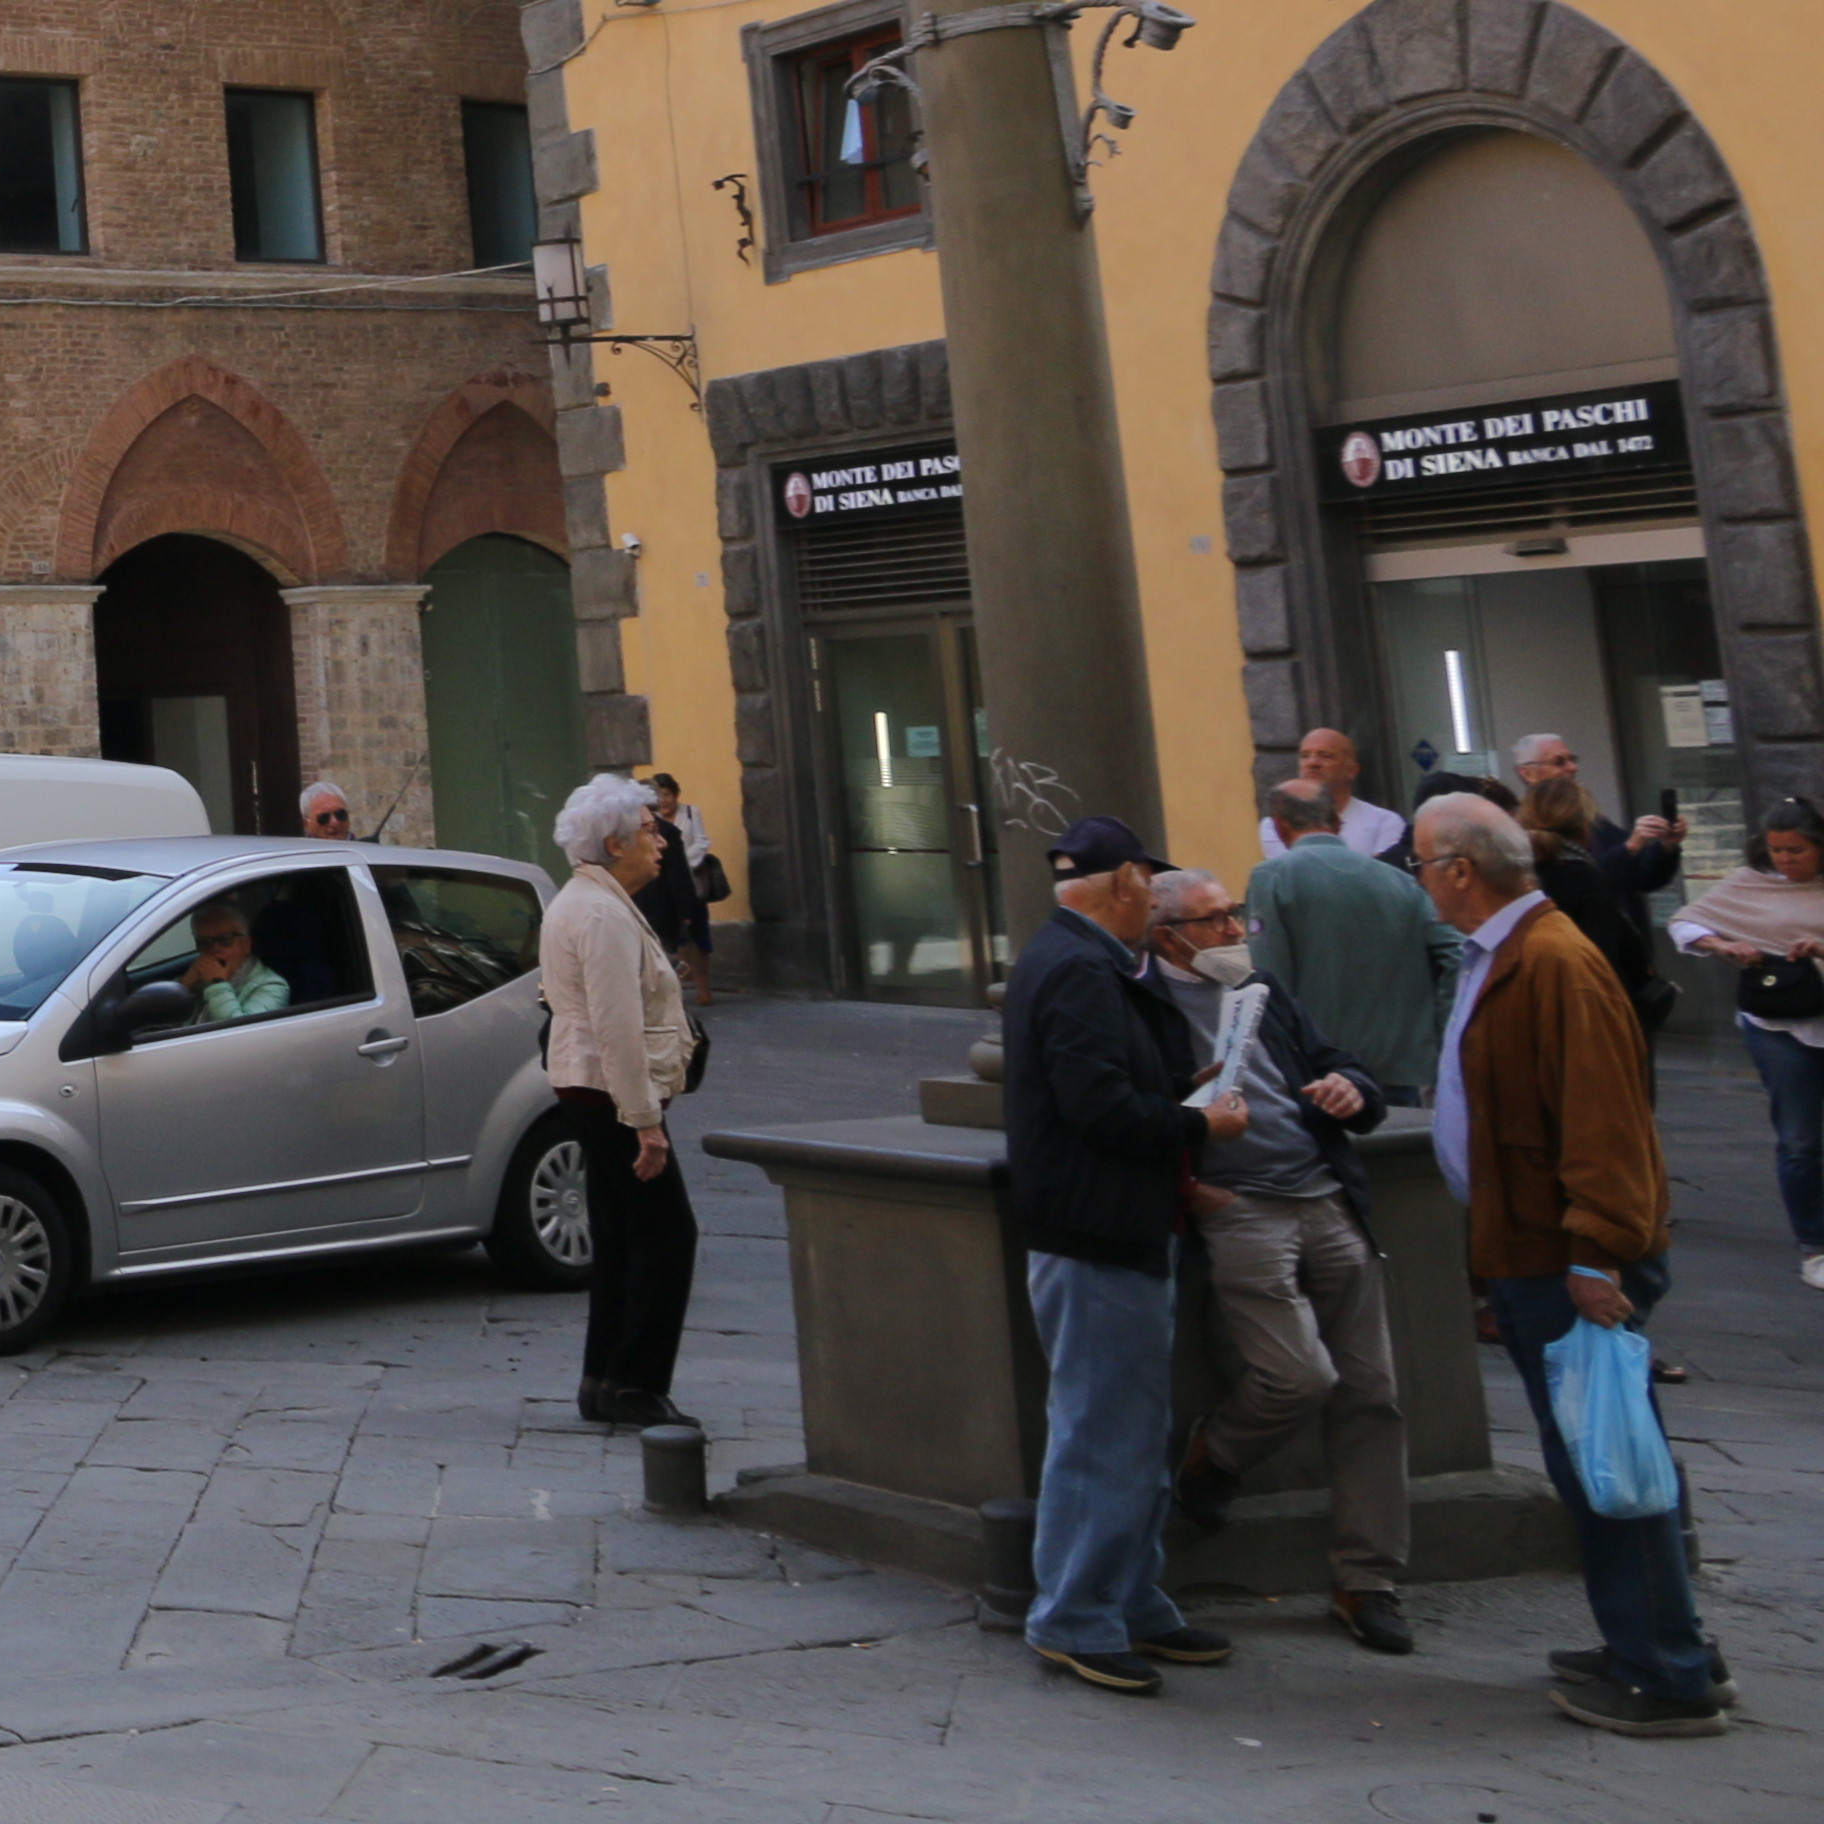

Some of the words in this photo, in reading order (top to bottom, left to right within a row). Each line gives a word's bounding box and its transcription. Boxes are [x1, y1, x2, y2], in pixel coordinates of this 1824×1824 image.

[1380, 421, 1478, 452] MONTE
[1483, 413, 1535, 439] DEI
[1541, 398, 1650, 432] PASCHI
[812, 465, 877, 490] MONTE
[881, 461, 916, 481] DEI
[1384, 458, 1415, 480] DI
[1420, 447, 1504, 476] SIENA
[1507, 444, 1569, 466] BANCA
[1573, 439, 1613, 458] DAL
[1617, 435, 1654, 453] 1472
[814, 495, 835, 513] DI
[839, 488, 895, 510] SIENA
[897, 487, 938, 503] BANCA
